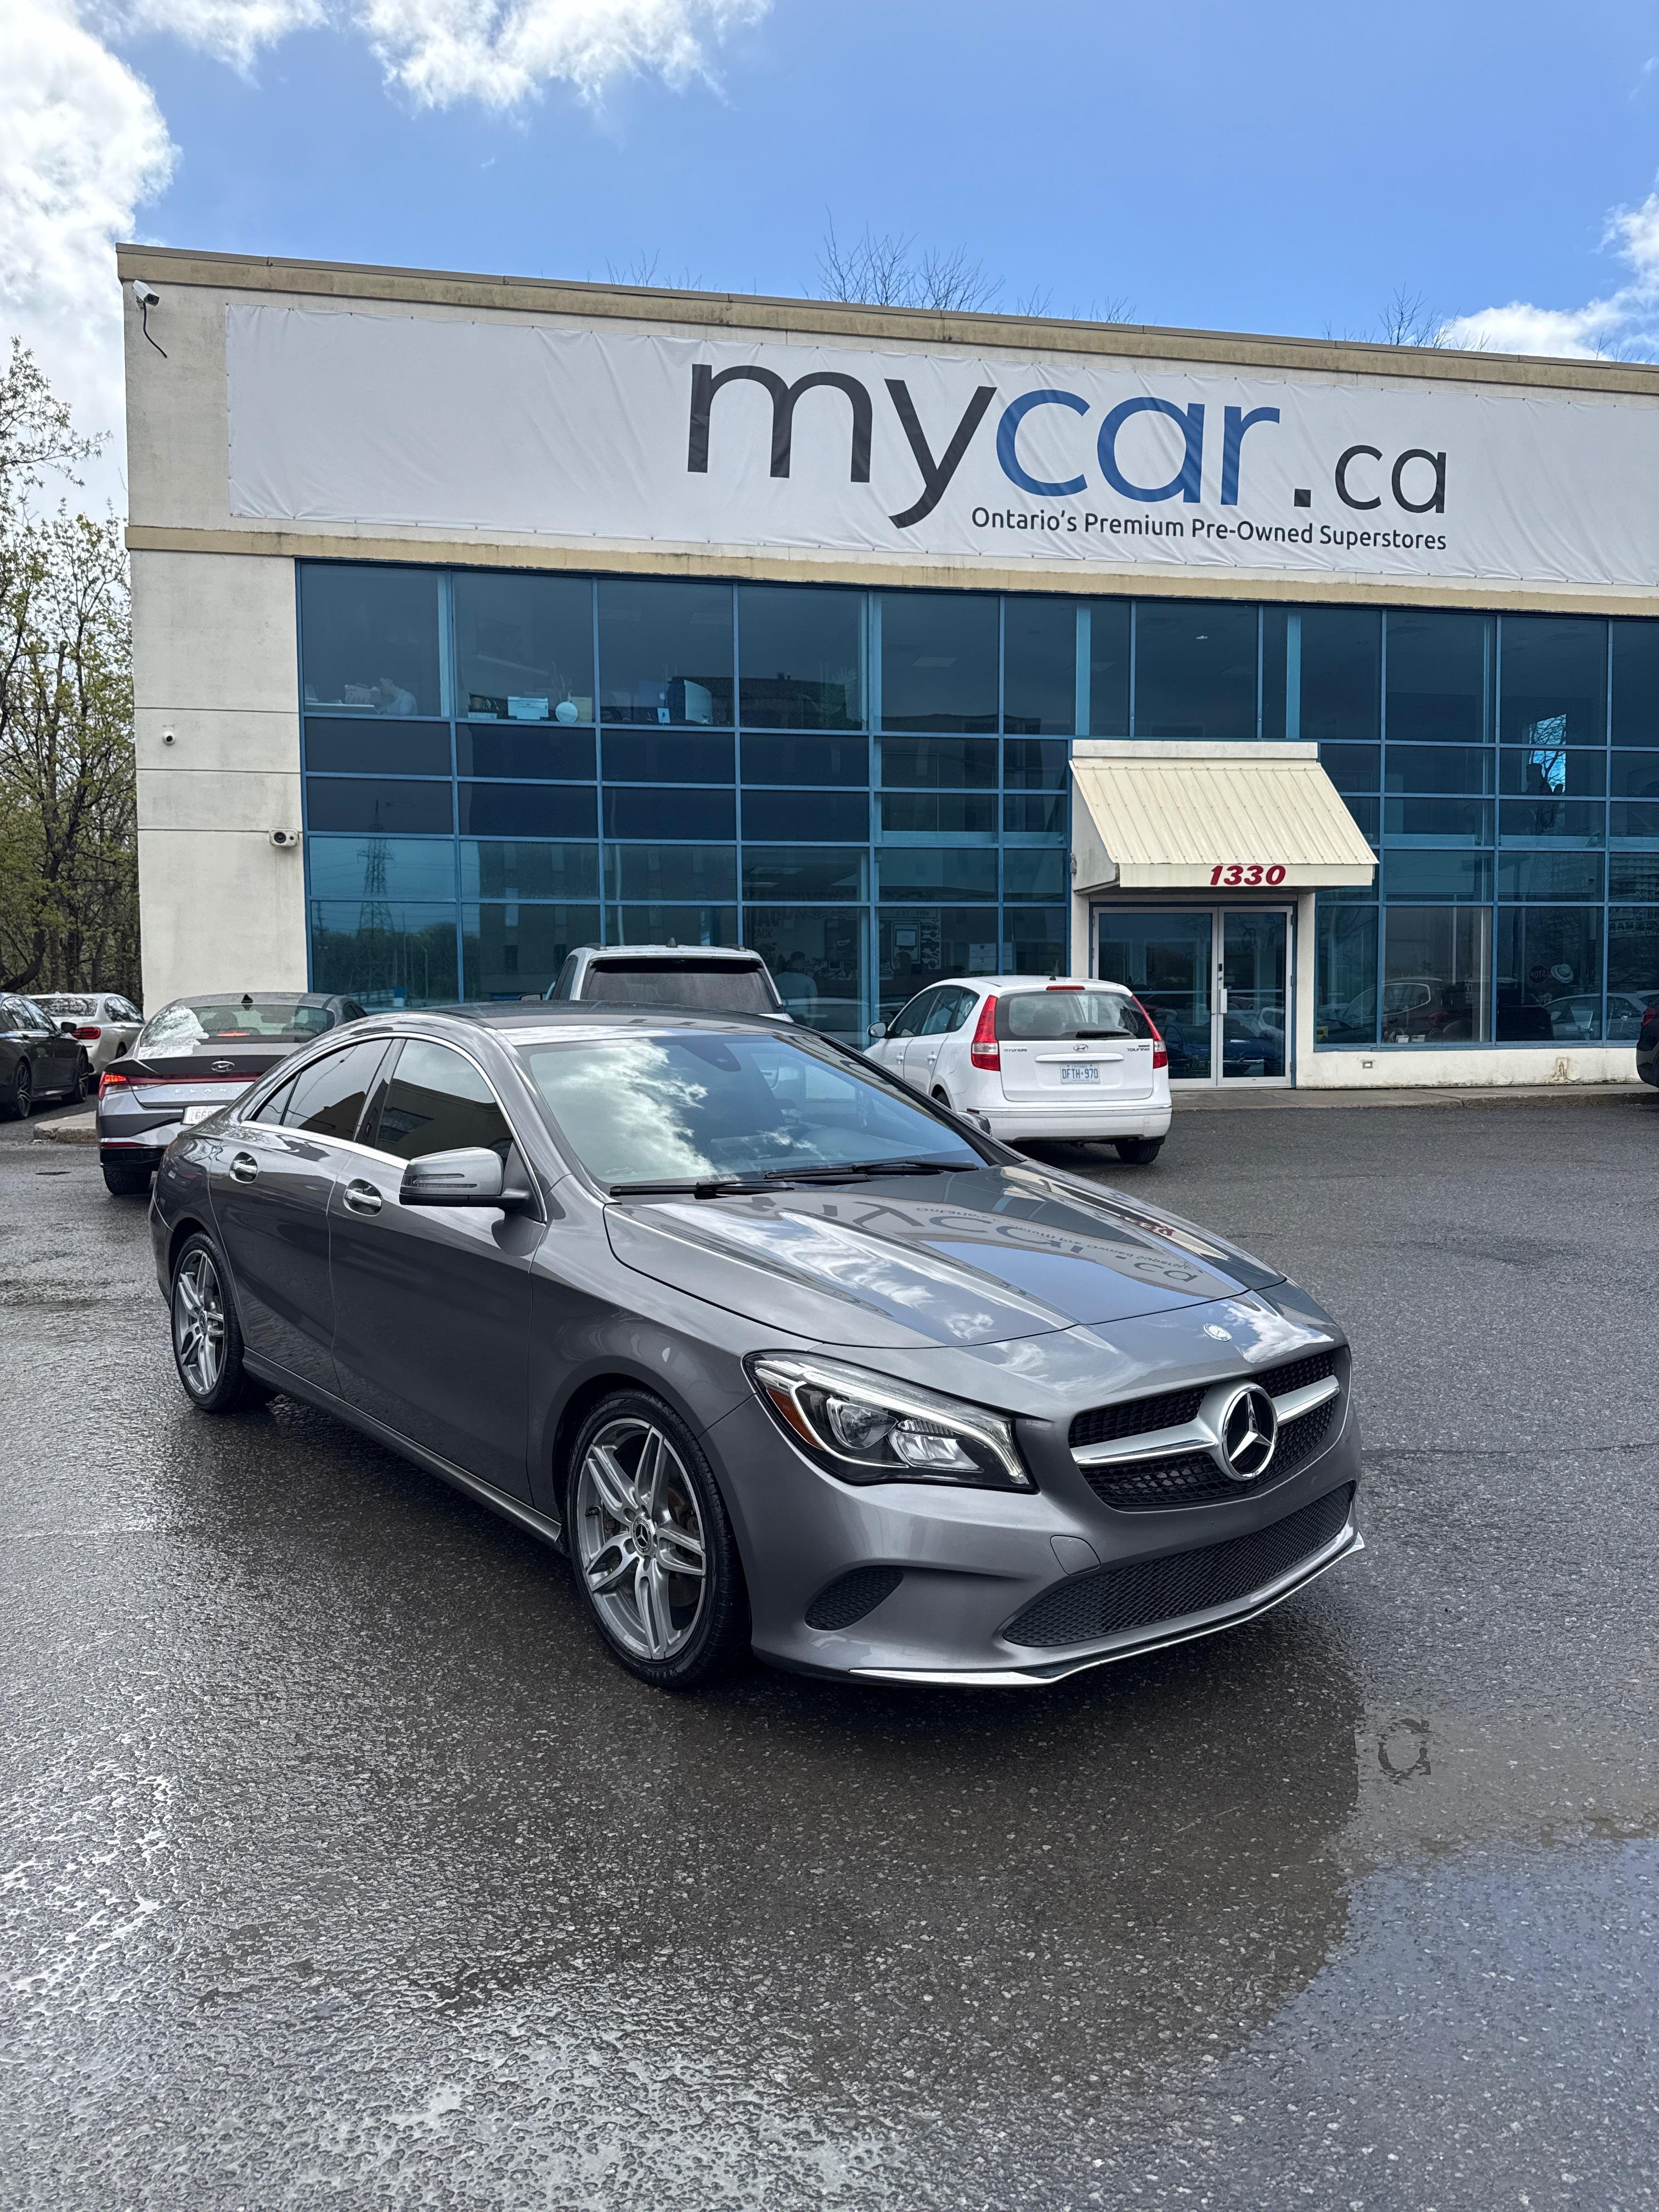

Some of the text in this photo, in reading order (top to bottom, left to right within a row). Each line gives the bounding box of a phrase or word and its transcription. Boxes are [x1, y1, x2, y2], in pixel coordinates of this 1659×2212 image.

[972, 507, 1446, 550] Ontario's Premium Pre-Owned Superstores
[1211, 865, 1286, 886] 1330
